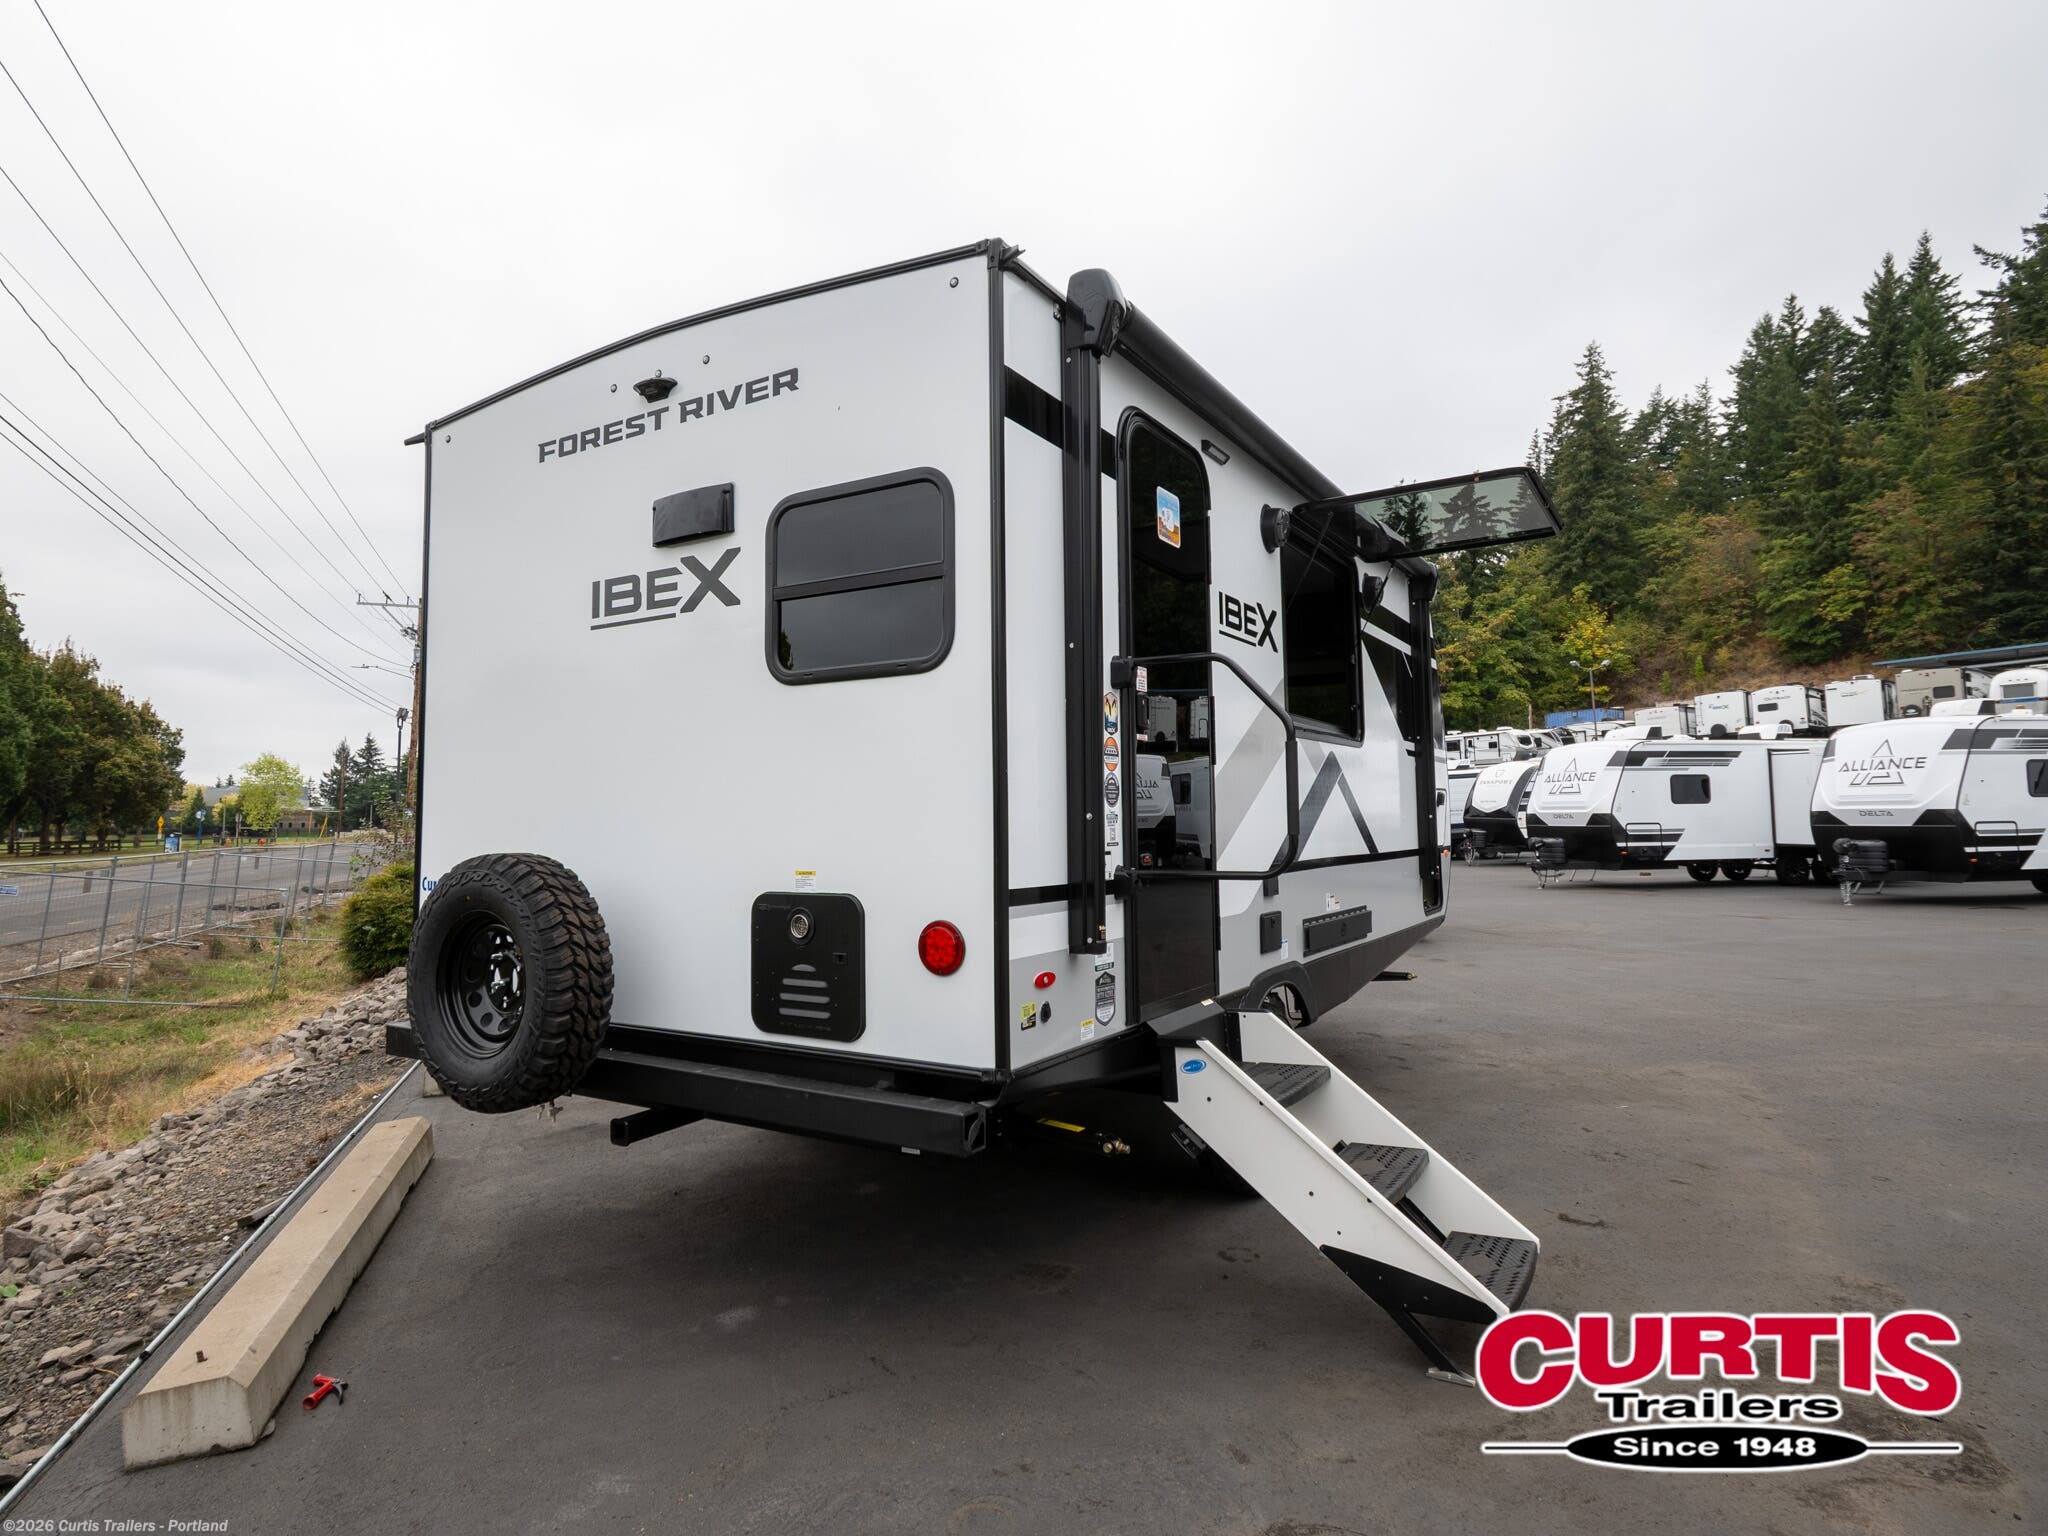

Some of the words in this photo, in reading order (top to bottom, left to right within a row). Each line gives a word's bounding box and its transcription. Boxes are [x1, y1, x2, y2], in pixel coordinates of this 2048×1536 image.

[538, 406, 670, 463] FOREST
[678, 367, 799, 424] RIVER
[591, 547, 741, 620] IBEX
[1219, 591, 1278, 653] IBEX
[1544, 771, 1597, 783] ALLIANCE
[1838, 756, 1927, 772] ALLIANCE
